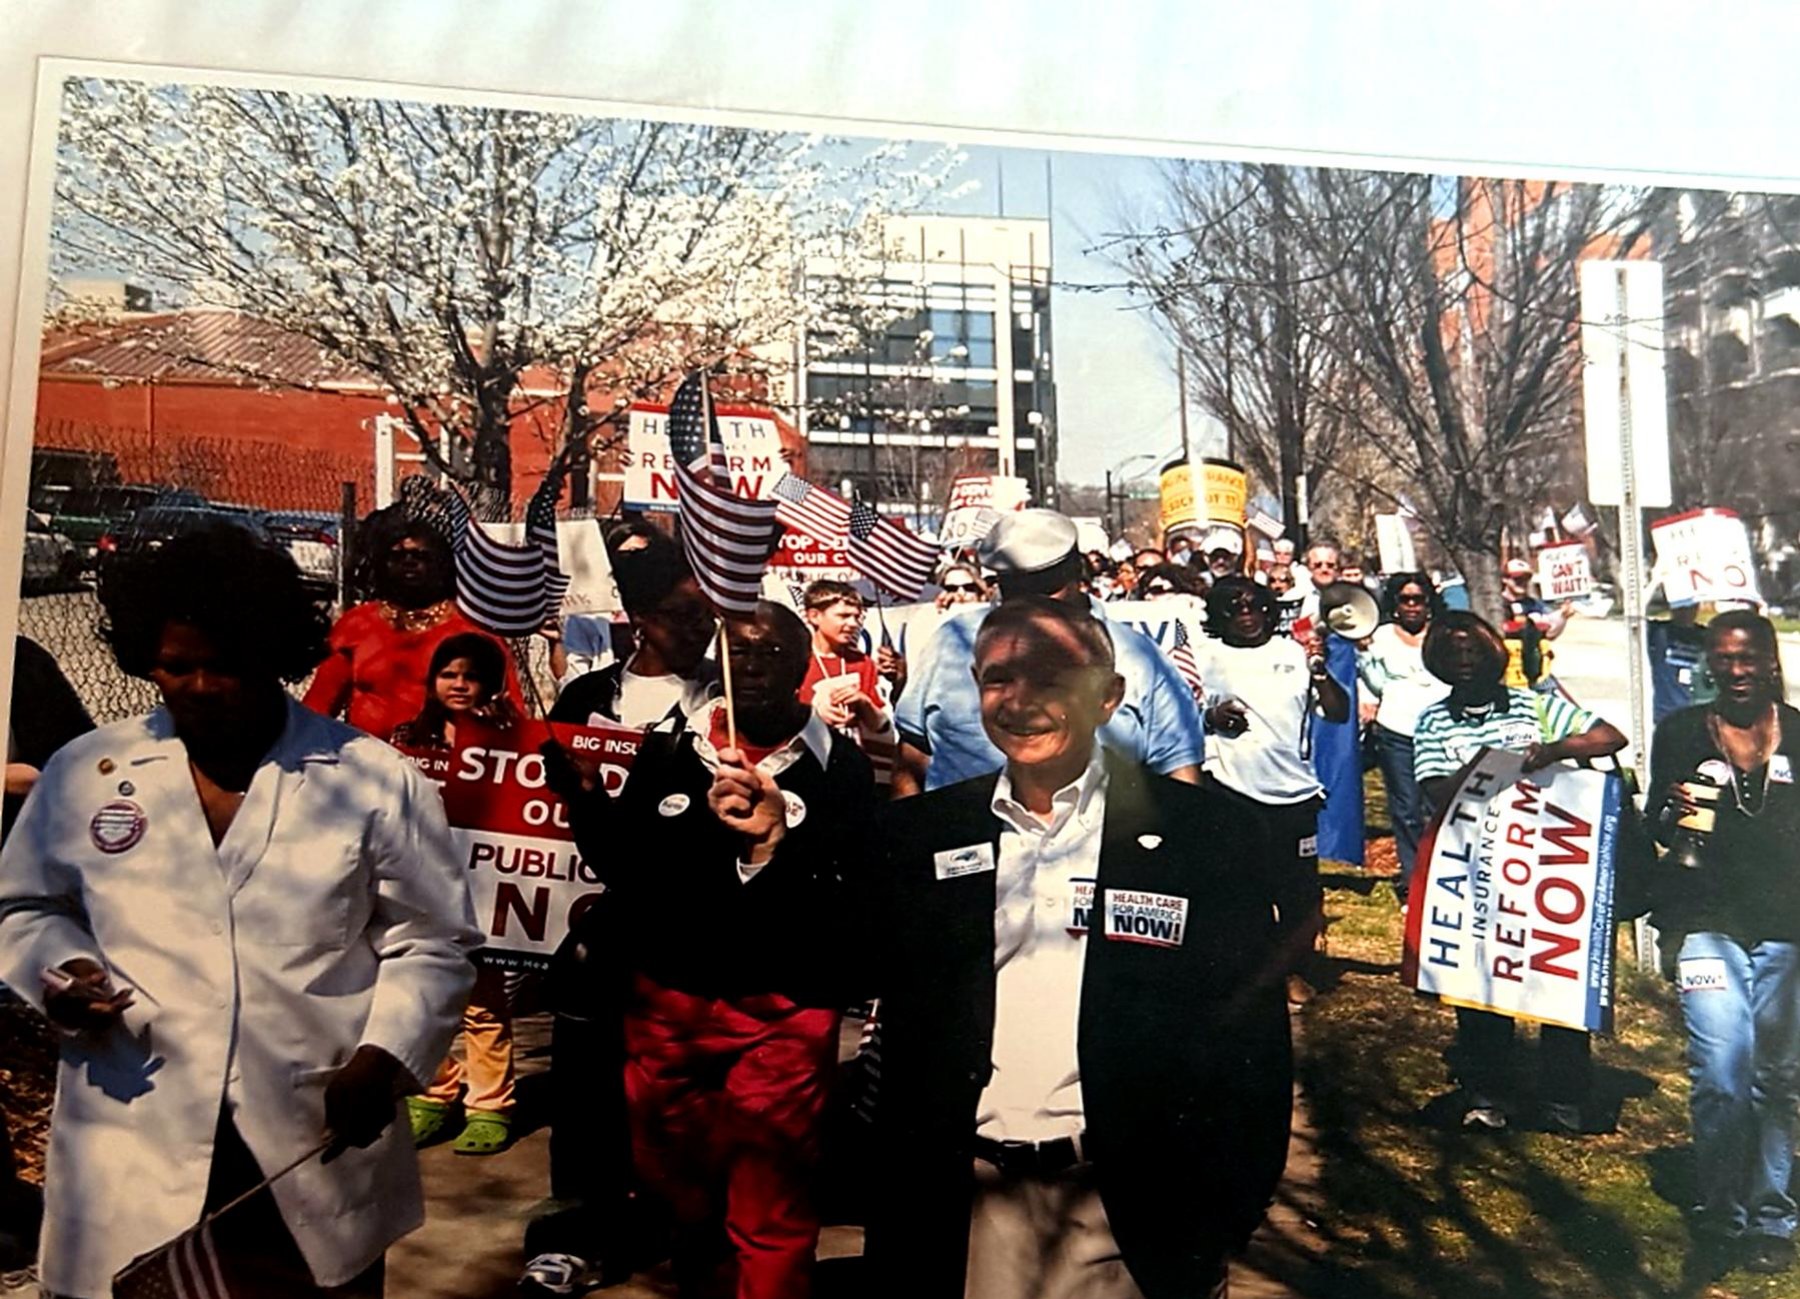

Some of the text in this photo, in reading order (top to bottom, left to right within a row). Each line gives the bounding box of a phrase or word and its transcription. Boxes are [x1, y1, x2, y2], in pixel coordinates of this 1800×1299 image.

[643, 418, 766, 439] HETH
[642, 452, 772, 473] RERM
[651, 472, 764, 500] NW
[778, 533, 815, 550] TOP
[793, 552, 846, 564] OUR C
[1551, 560, 1583, 578] CAN'T
[1551, 577, 1589, 595] WAIT!
[572, 734, 601, 751] BIG
[434, 760, 449, 773] IN
[457, 746, 630, 798] STO D
[522, 800, 571, 829] OU
[468, 842, 604, 885] PUBLIC
[1428, 770, 1496, 968] HEALTH
[1471, 805, 1501, 940] INSURANCE
[1492, 780, 1543, 983] REFORM
[1529, 801, 1592, 981] NOW
[1112, 892, 1184, 912] HEALTH CARE
[1072, 907, 1093, 927] N
[1112, 903, 1183, 923] FOR AMERICA
[1113, 914, 1182, 943] NOW!
